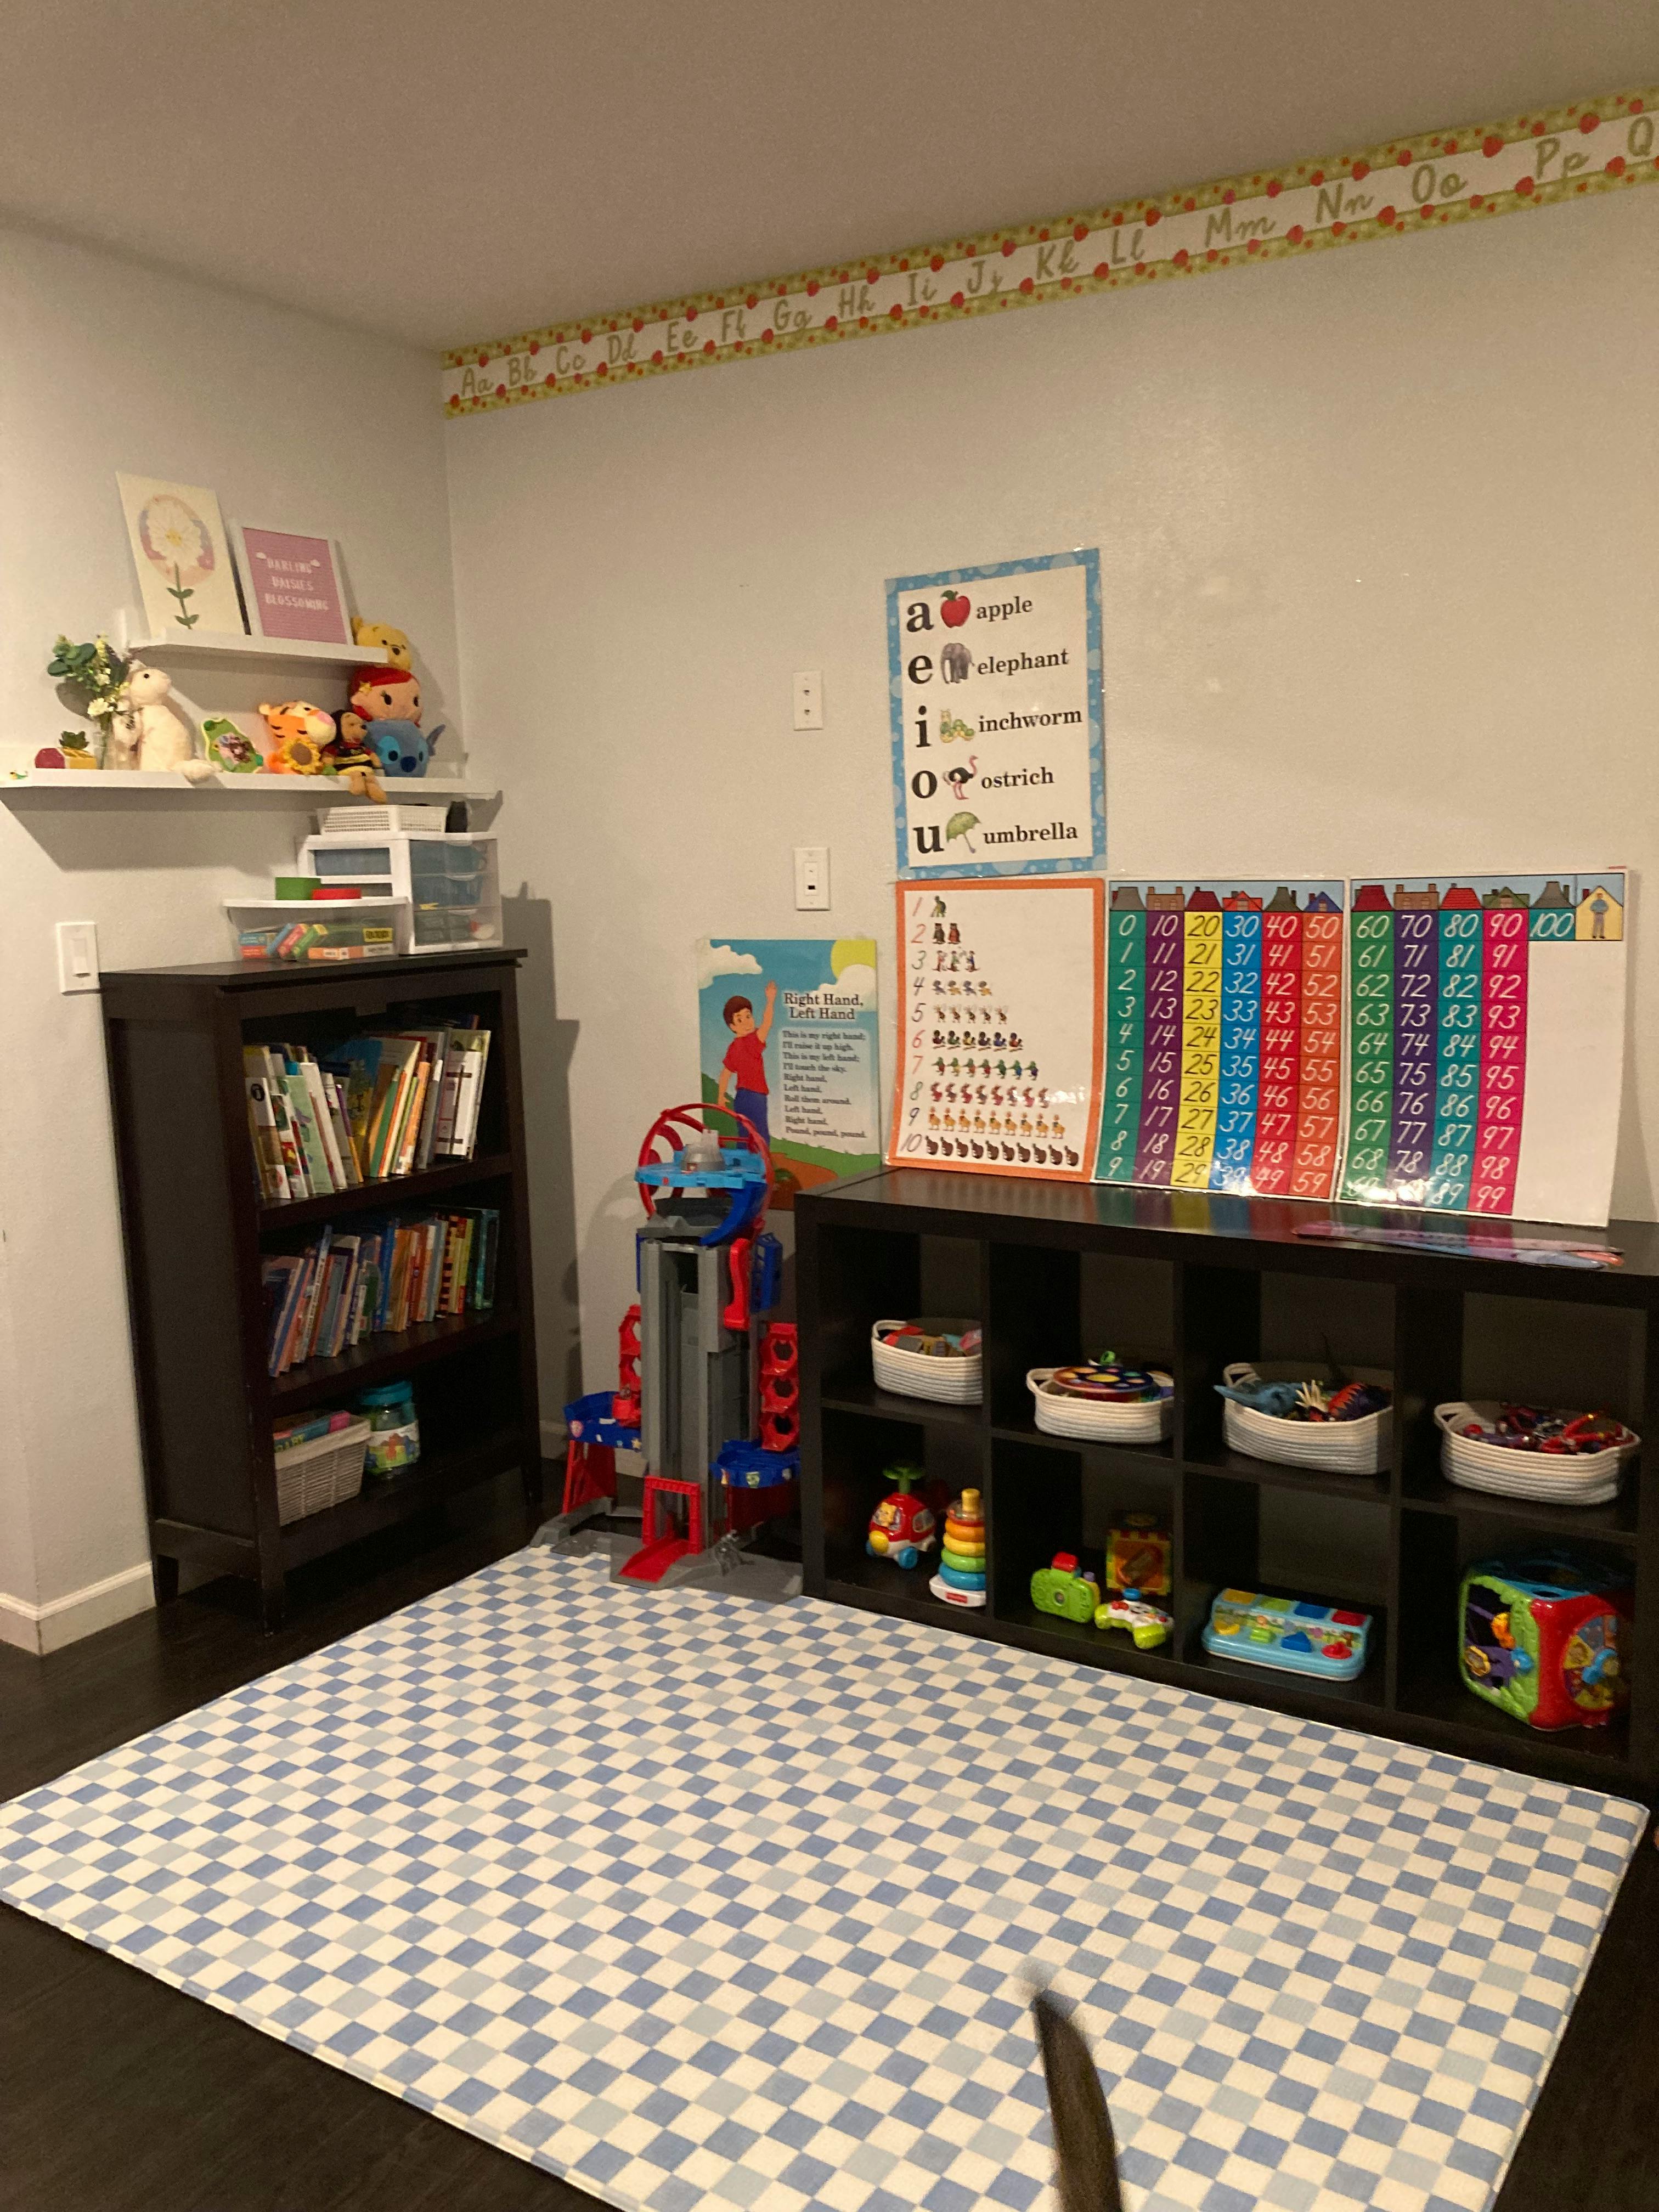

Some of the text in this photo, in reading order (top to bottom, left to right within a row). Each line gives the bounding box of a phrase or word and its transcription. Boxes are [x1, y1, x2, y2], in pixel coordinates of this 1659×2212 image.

[461, 367, 494, 396] Aa
[507, 355, 537, 386] Bb
[607, 333, 639, 364] Dd
[667, 321, 698, 352] Ee
[839, 285, 876, 318] Hh
[907, 272, 938, 306] Ii
[1036, 239, 1079, 280] Kk
[1111, 228, 1146, 266] Ll
[1205, 206, 1277, 247] Mm
[1316, 184, 1374, 223] Nn
[1412, 163, 1468, 204] Oo
[1534, 137, 1592, 180] Pp
[906, 596, 1032, 633] a apple
[907, 648, 1068, 684] e elephant
[915, 705, 1082, 748] i inchworm
[911, 766, 1054, 799] o ostrich
[912, 822, 1078, 854] u umbrella
[912, 896, 923, 917] 1
[910, 923, 926, 944] 2
[1119, 914, 1339, 939] 0 10 20 30 40 50
[1356, 912, 1575, 939] 60 70 80 90 100
[911, 950, 926, 970] 3
[1120, 942, 1336, 968] 1 11 21 31 41 51
[1358, 944, 1518, 968] 61 71 81 91
[913, 977, 925, 997] 4
[1118, 969, 1338, 997] 2 12 22 32 42 52
[1356, 974, 1521, 999] 62 72 82 92
[784, 992, 864, 1007] Right Hand,
[789, 1007, 855, 1019] Left Hand
[912, 1002, 927, 1023] 5
[1118, 996, 1337, 1025] 3 13 23 33 43 53
[1356, 1003, 1521, 1029] 63 73 83 93
[821, 1032, 840, 1040] right
[912, 1029, 926, 1049] 6
[1119, 1023, 1336, 1053] 4 14 24 34 44 54
[1358, 1032, 1519, 1059] 64 74 84 94
[911, 1054, 925, 1076] 7
[1116, 1049, 1337, 1082] 5 15 25 35 45 55
[1356, 1061, 1519, 1090] 65 75 85 95
[910, 1081, 923, 1102] 8
[1116, 1077, 1335, 1110] 6 16 26 36 46 56
[1356, 1090, 1517, 1120] 66 76 86 96
[909, 1107, 920, 1127] 9
[1114, 1103, 1334, 1138] 7 17 27 37 47 57
[900, 1133, 923, 1153] 10
[1355, 1119, 1515, 1150] 67 77 87 97
[1110, 1130, 1331, 1167] 8 18 28 38 48 58
[1108, 1156, 1123, 1177] 9
[1139, 1160, 1166, 1180] 19
[1174, 1163, 1207, 1183] 29
[1255, 1167, 1284, 1190] 49
[1293, 1171, 1328, 1193] 59
[1351, 1148, 1510, 1180] 68 78 88 98
[1431, 1181, 1465, 1206] 89
[1475, 1185, 1506, 1209] 99
